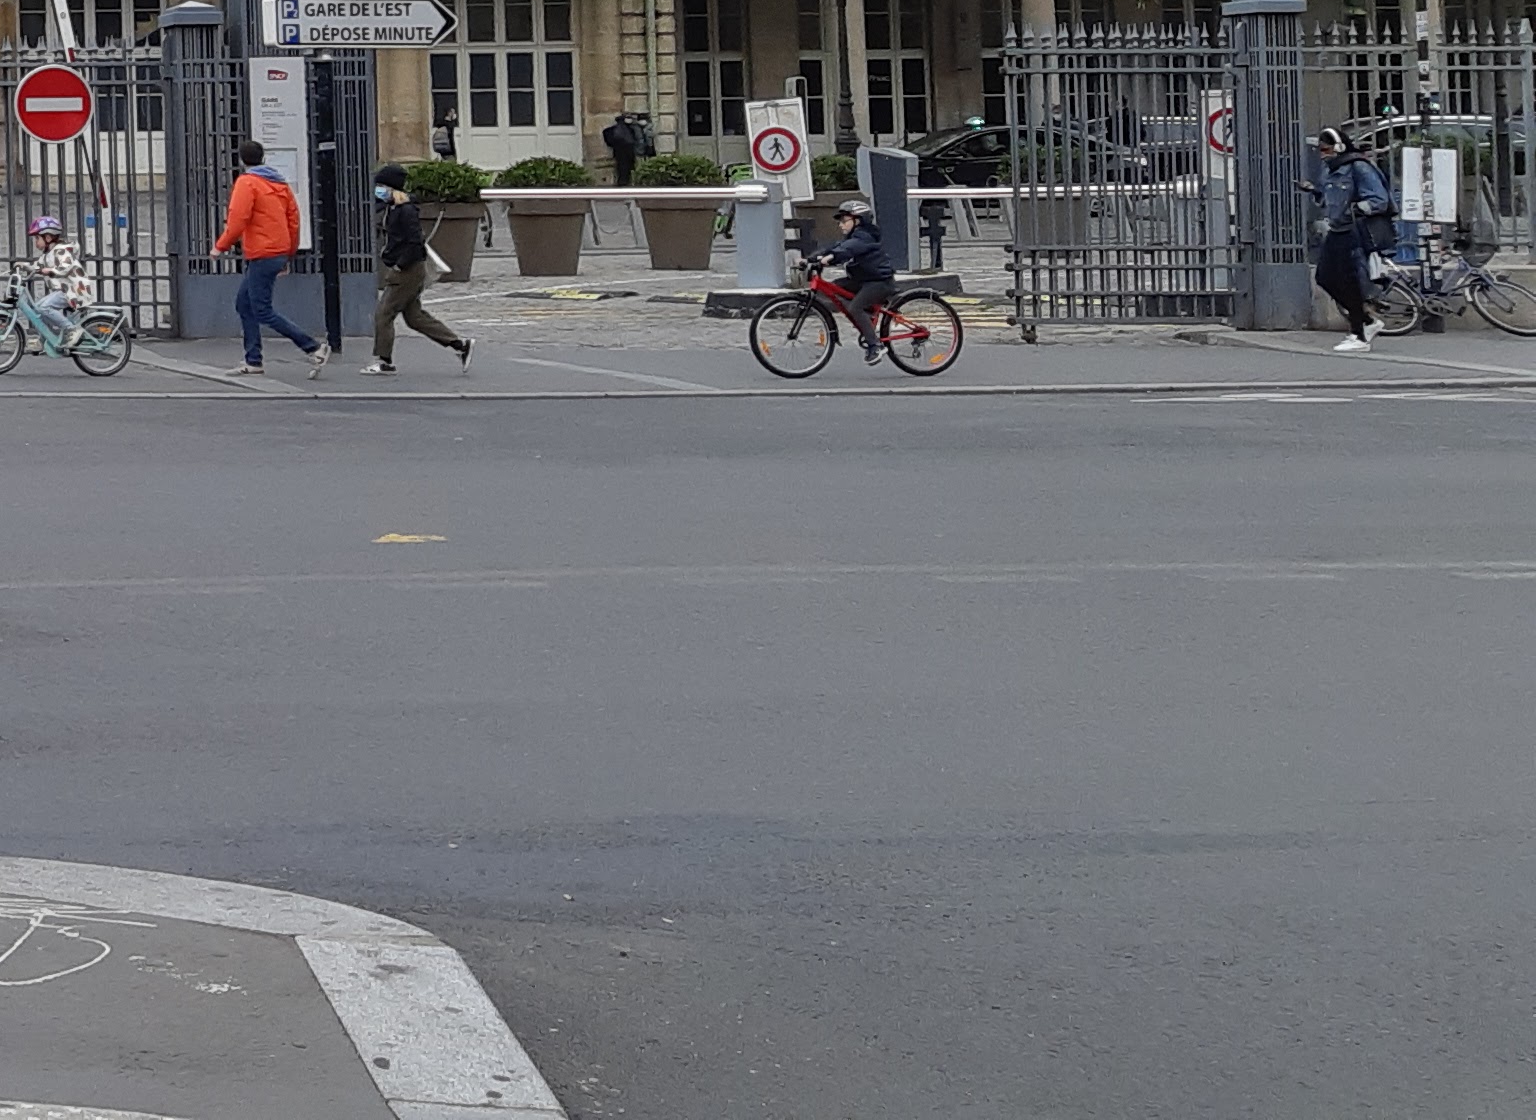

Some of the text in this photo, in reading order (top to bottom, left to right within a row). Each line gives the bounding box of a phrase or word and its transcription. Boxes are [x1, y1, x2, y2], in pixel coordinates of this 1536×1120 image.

[304, 2, 345, 17] GARE
[350, 2, 370, 17] DE
[373, 1, 413, 17] L'EST
[310, 24, 370, 41] DÉPOSE
[374, 26, 434, 41] MINUTE
